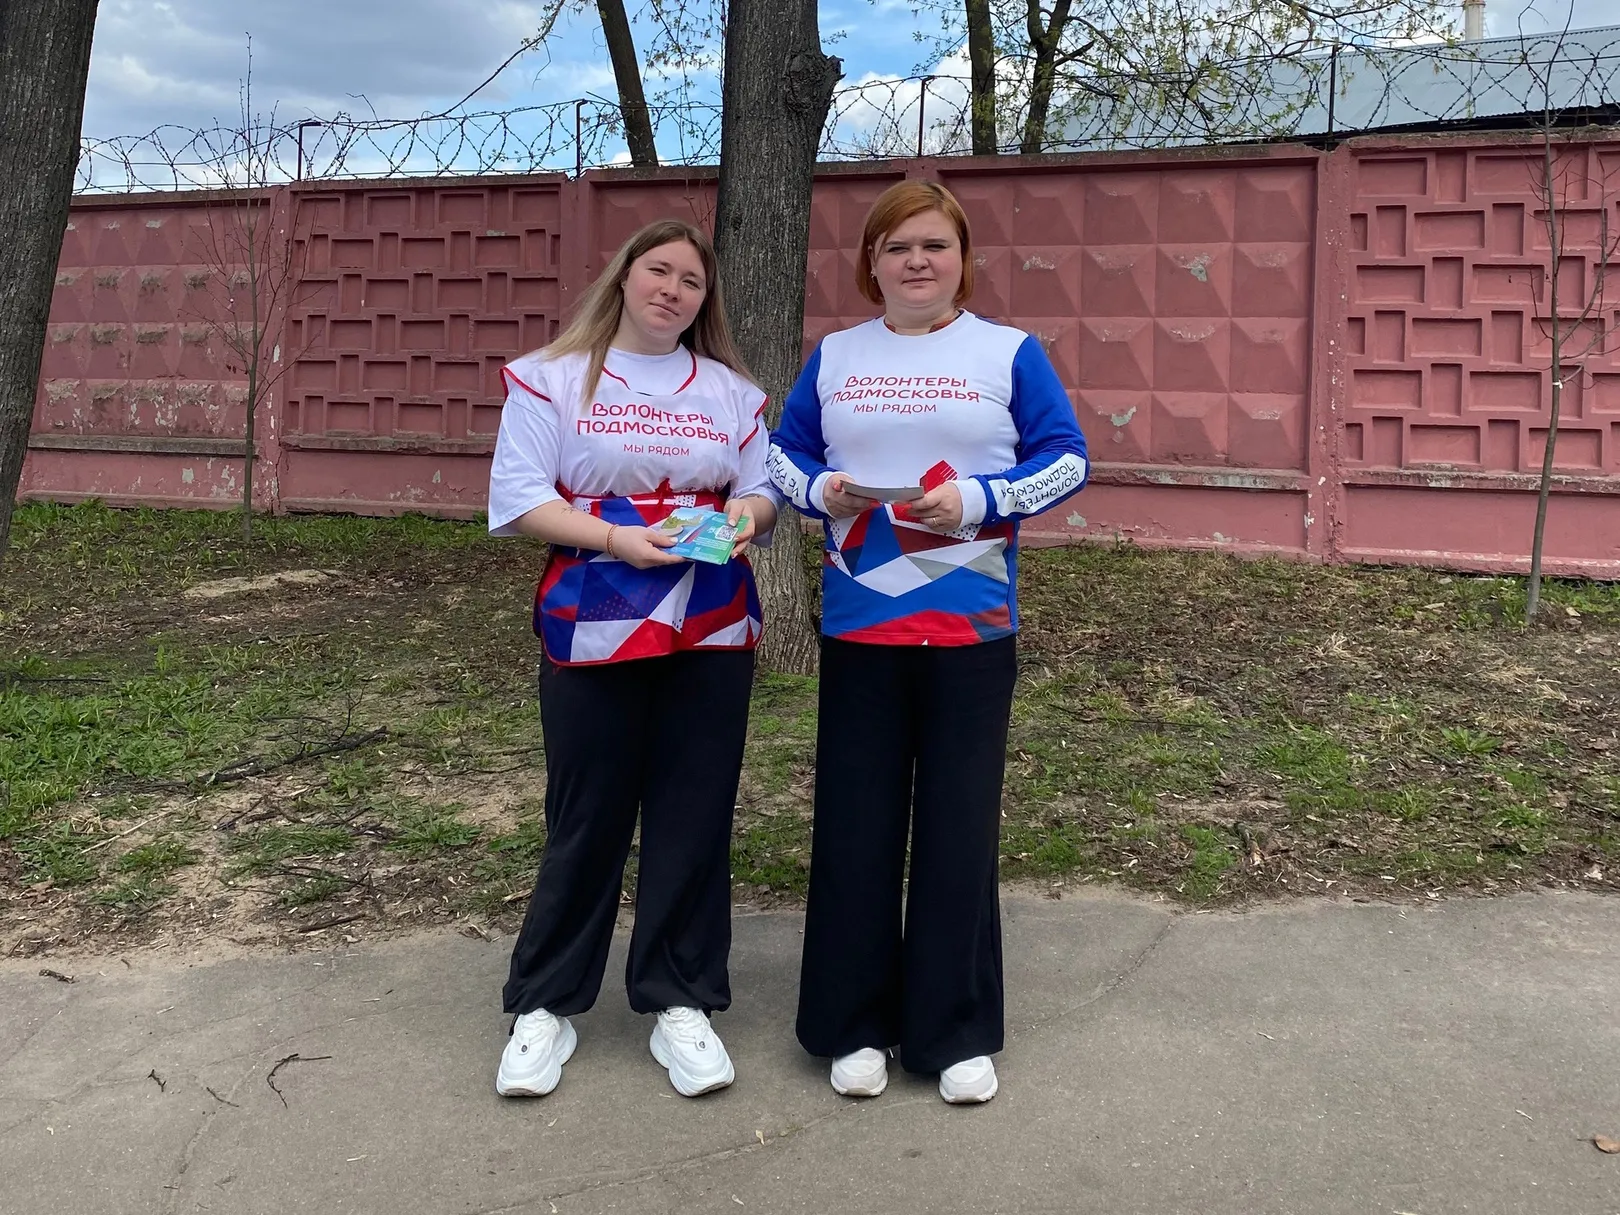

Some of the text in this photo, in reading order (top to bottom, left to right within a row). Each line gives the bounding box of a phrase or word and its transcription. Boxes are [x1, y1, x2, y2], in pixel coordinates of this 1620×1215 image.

[845, 375, 967, 388] ВОЛОНТЕРЫ
[831, 388, 980, 406] ПОДМОСКОВЬЯ
[592, 403, 714, 426] ВОЛОНТЕРЫ
[853, 403, 937, 415] МЫ РЯДОМ
[577, 419, 729, 446] ПОДМОСКОВЬЯ
[623, 443, 690, 456] МЫ РЯДОМ
[1014, 470, 1081, 510] ВОЛОНТЕЫ
